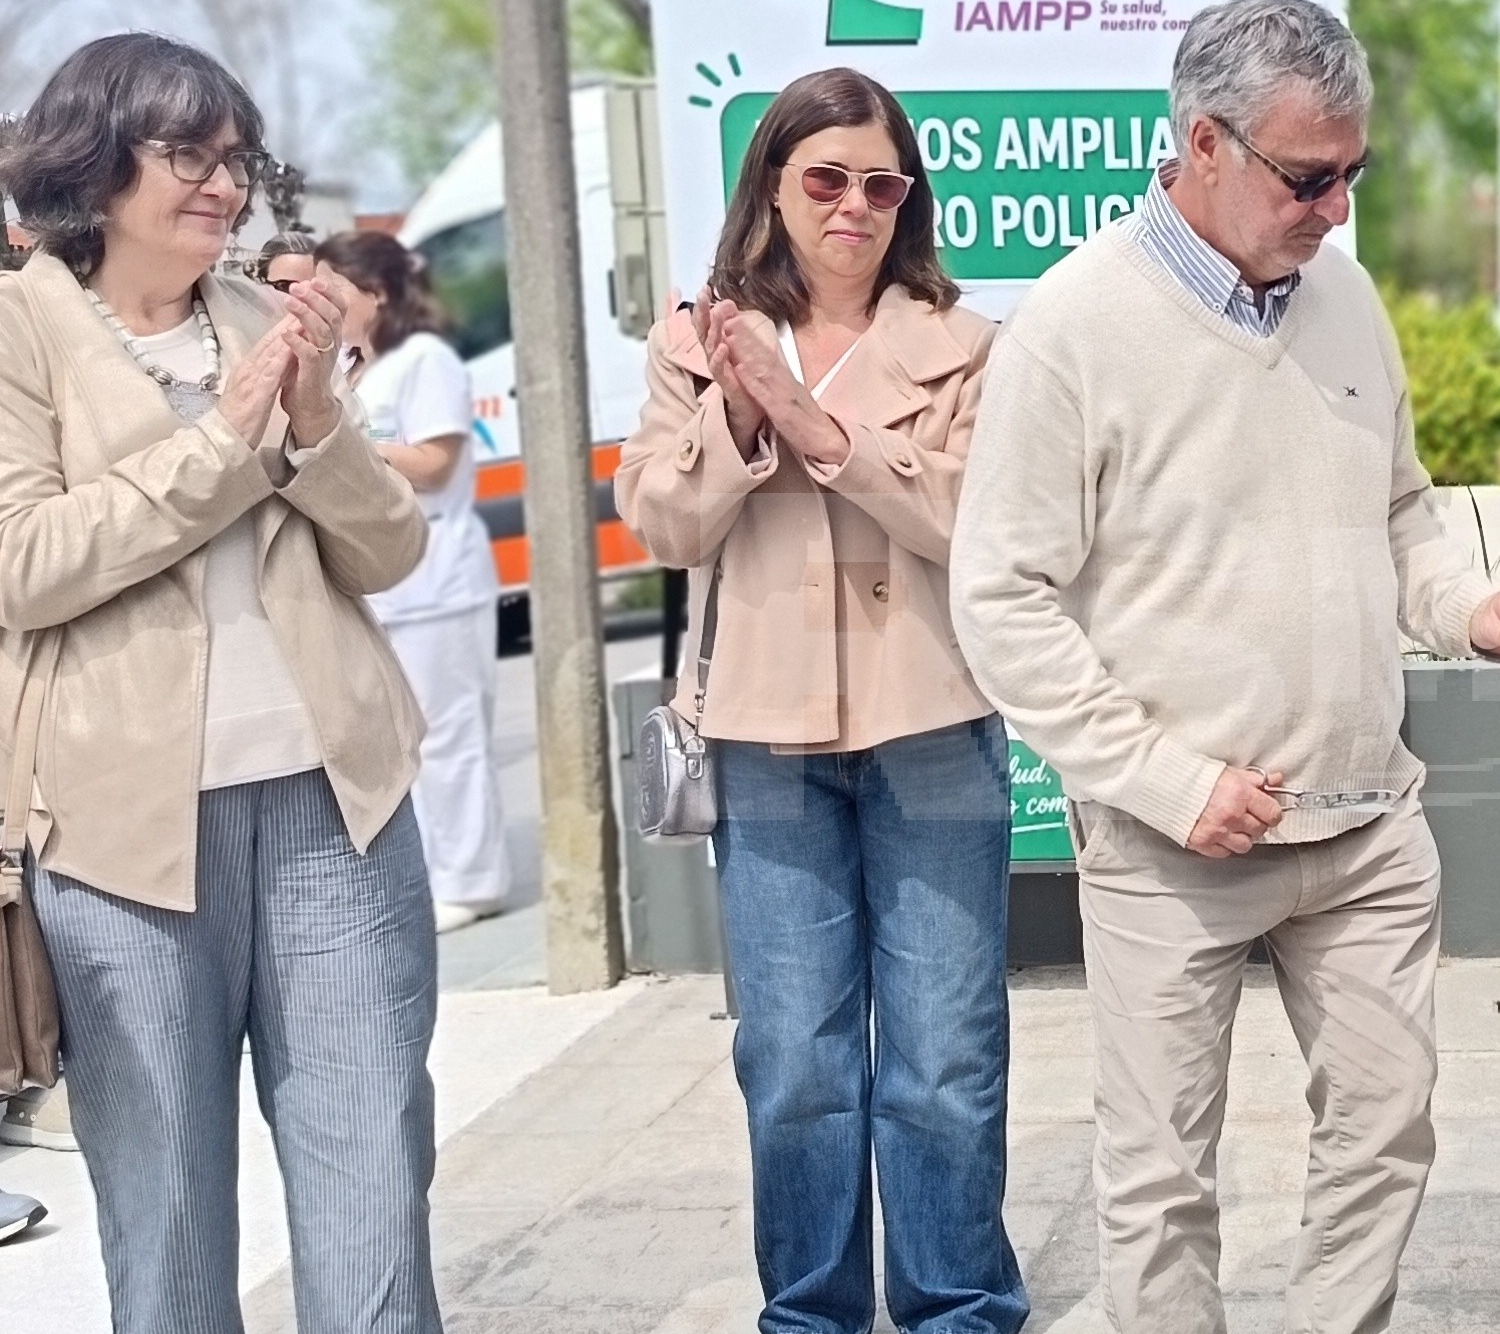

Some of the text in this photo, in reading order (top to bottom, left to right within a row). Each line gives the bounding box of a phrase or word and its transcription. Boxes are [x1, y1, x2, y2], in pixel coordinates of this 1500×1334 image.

[954, 0, 1093, 32] IAMPP
[1100, 0, 1117, 14] Su
[1100, 17, 1160, 32] nuestro
[1025, 795, 1069, 826] com
